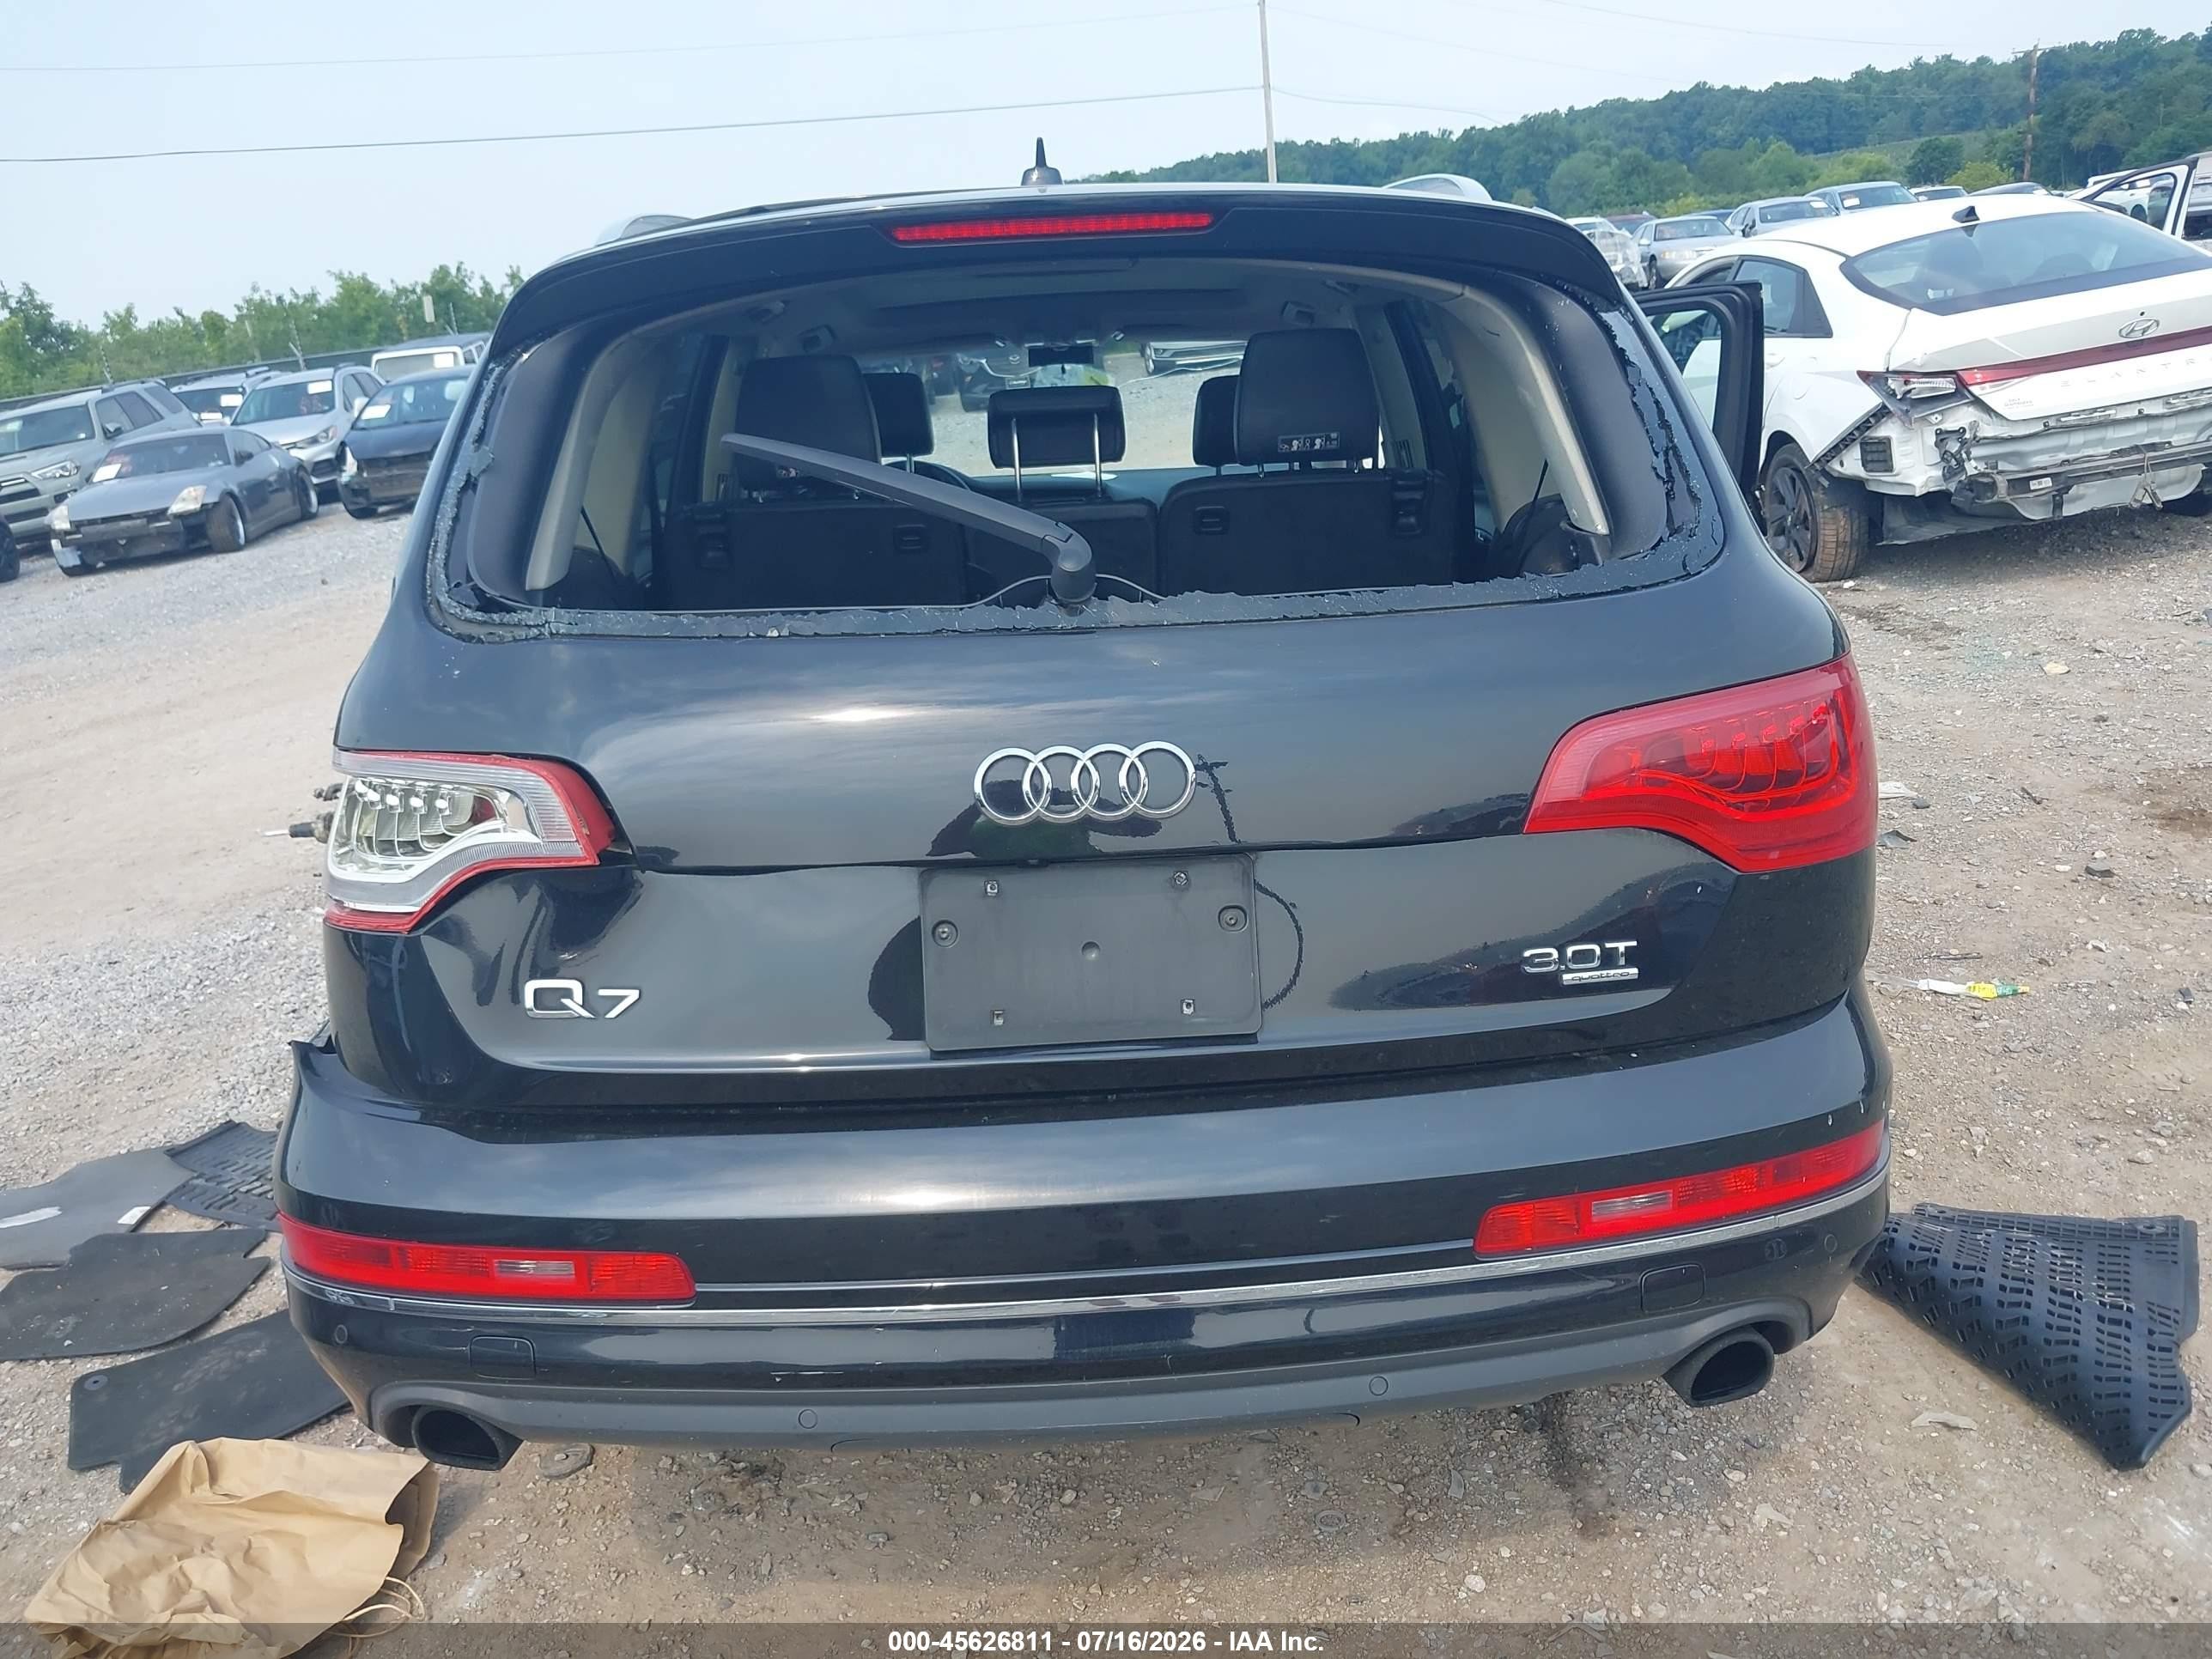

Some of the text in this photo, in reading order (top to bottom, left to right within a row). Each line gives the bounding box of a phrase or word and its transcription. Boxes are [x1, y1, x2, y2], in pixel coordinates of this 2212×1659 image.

[2060, 356, 2212, 388] ELANTR
[1522, 940, 1638, 974] 3.0T
[1571, 970, 1631, 982] quattro
[524, 978, 641, 1019] Q7
